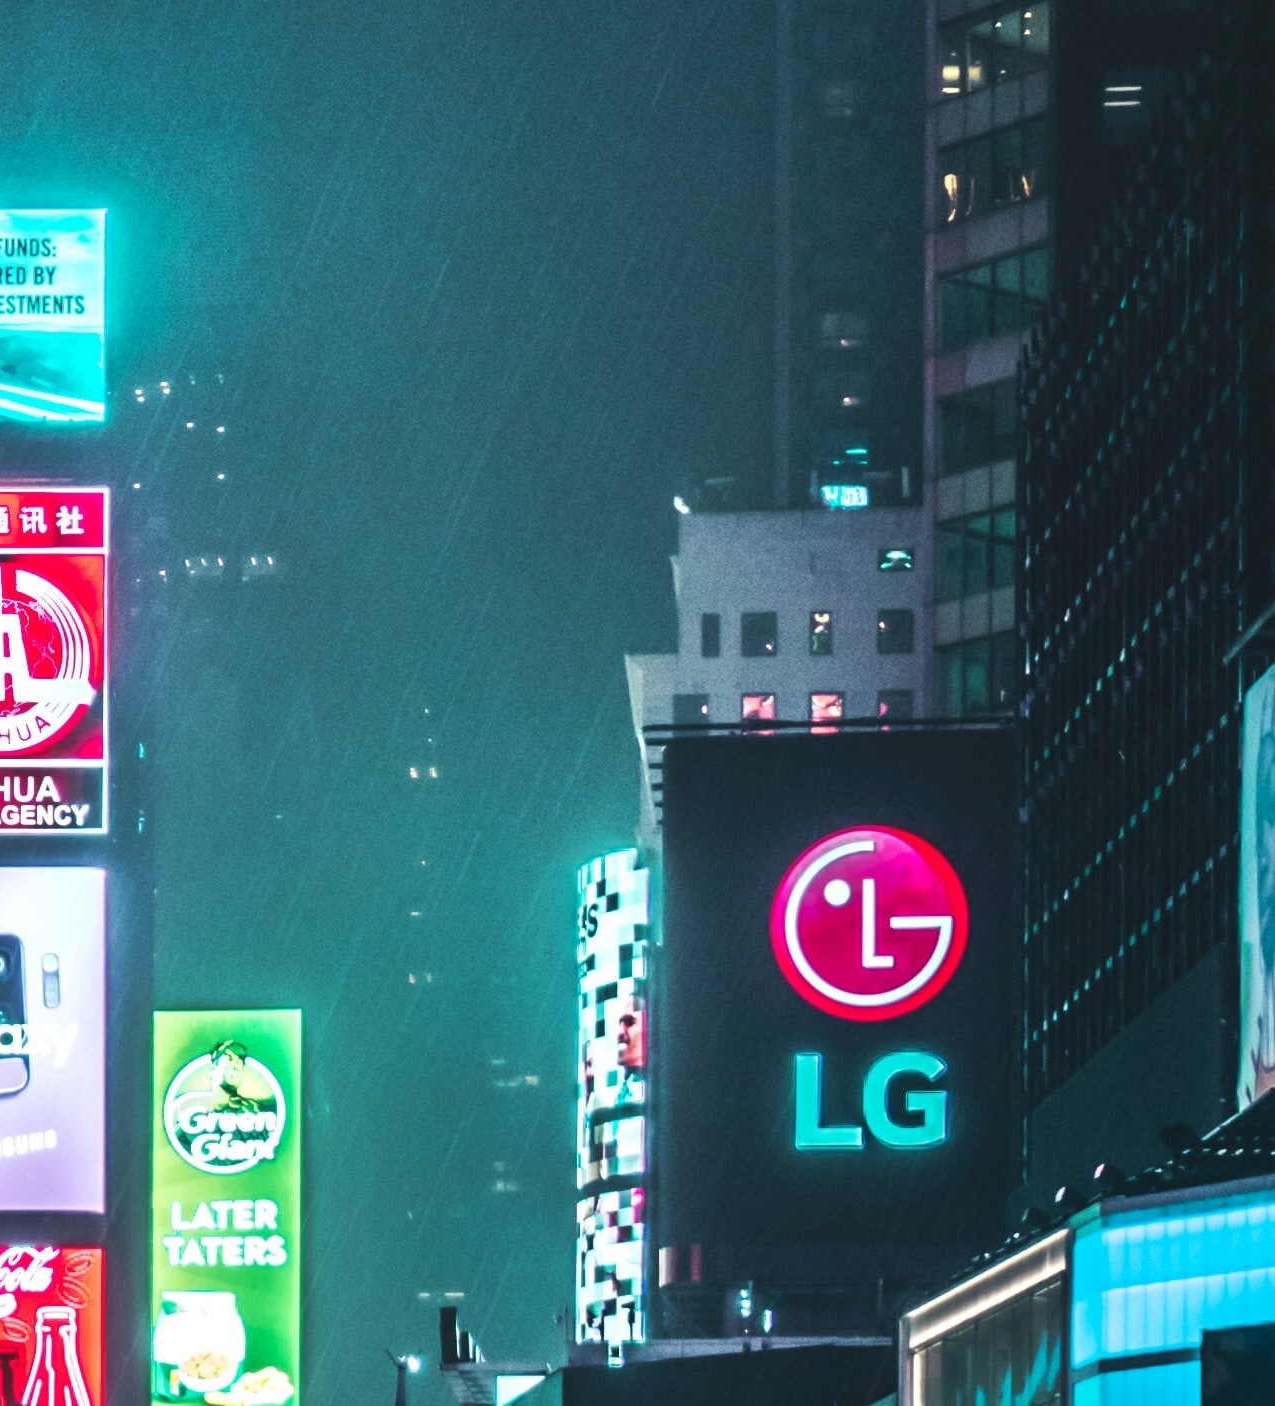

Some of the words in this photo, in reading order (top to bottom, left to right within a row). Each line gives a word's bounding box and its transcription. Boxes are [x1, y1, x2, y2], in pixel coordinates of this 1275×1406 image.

[33, 266, 57, 285] BY
[795, 1052, 948, 1149] LG
[179, 1106, 276, 1134] Green
[190, 1134, 279, 1162] Giant
[171, 1200, 278, 1230] LATER
[162, 1235, 287, 1267] TATERS
